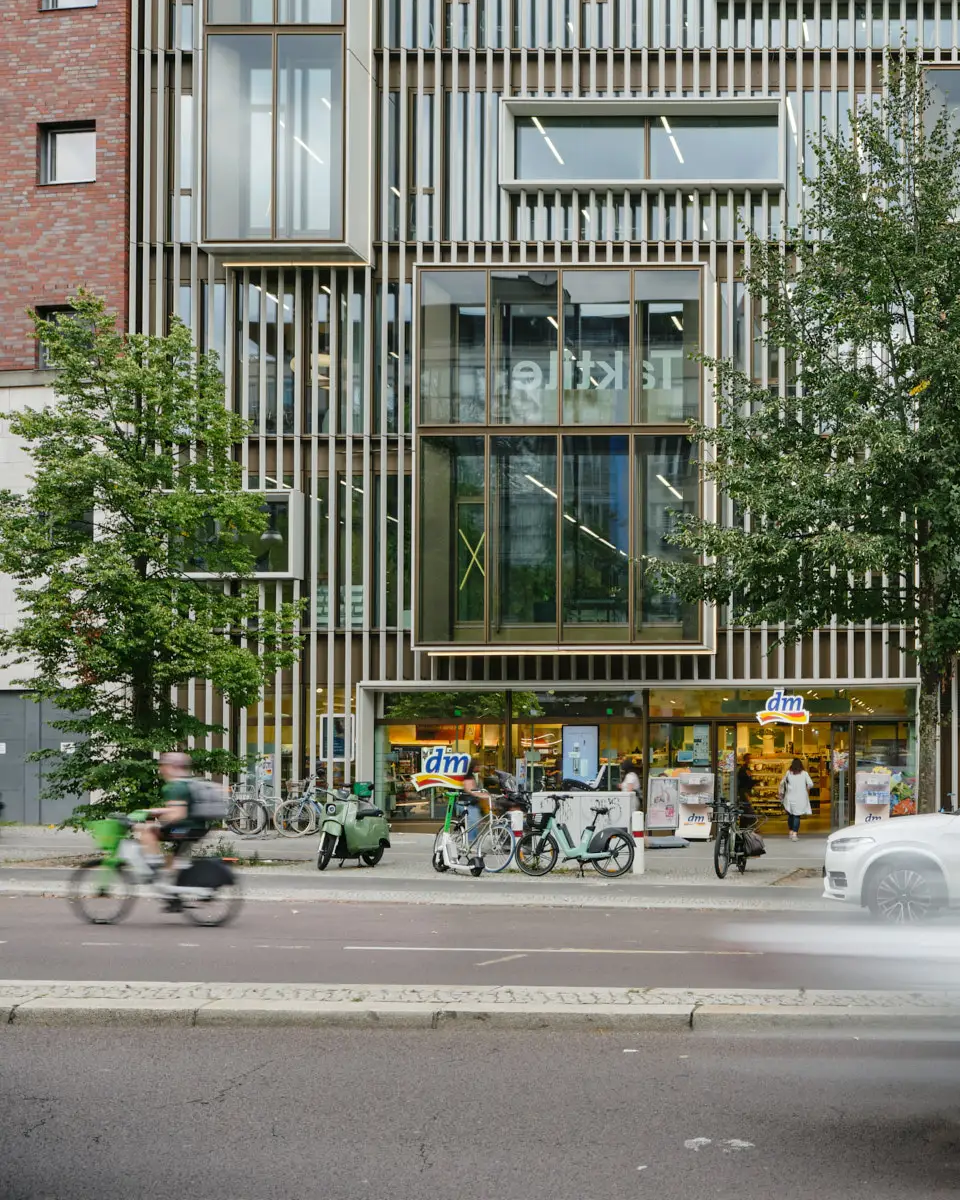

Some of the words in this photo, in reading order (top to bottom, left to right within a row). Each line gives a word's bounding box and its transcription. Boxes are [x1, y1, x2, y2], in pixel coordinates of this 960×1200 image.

[767, 691, 802, 711] dm
[425, 748, 469, 773] dm
[687, 812, 705, 822] dm
